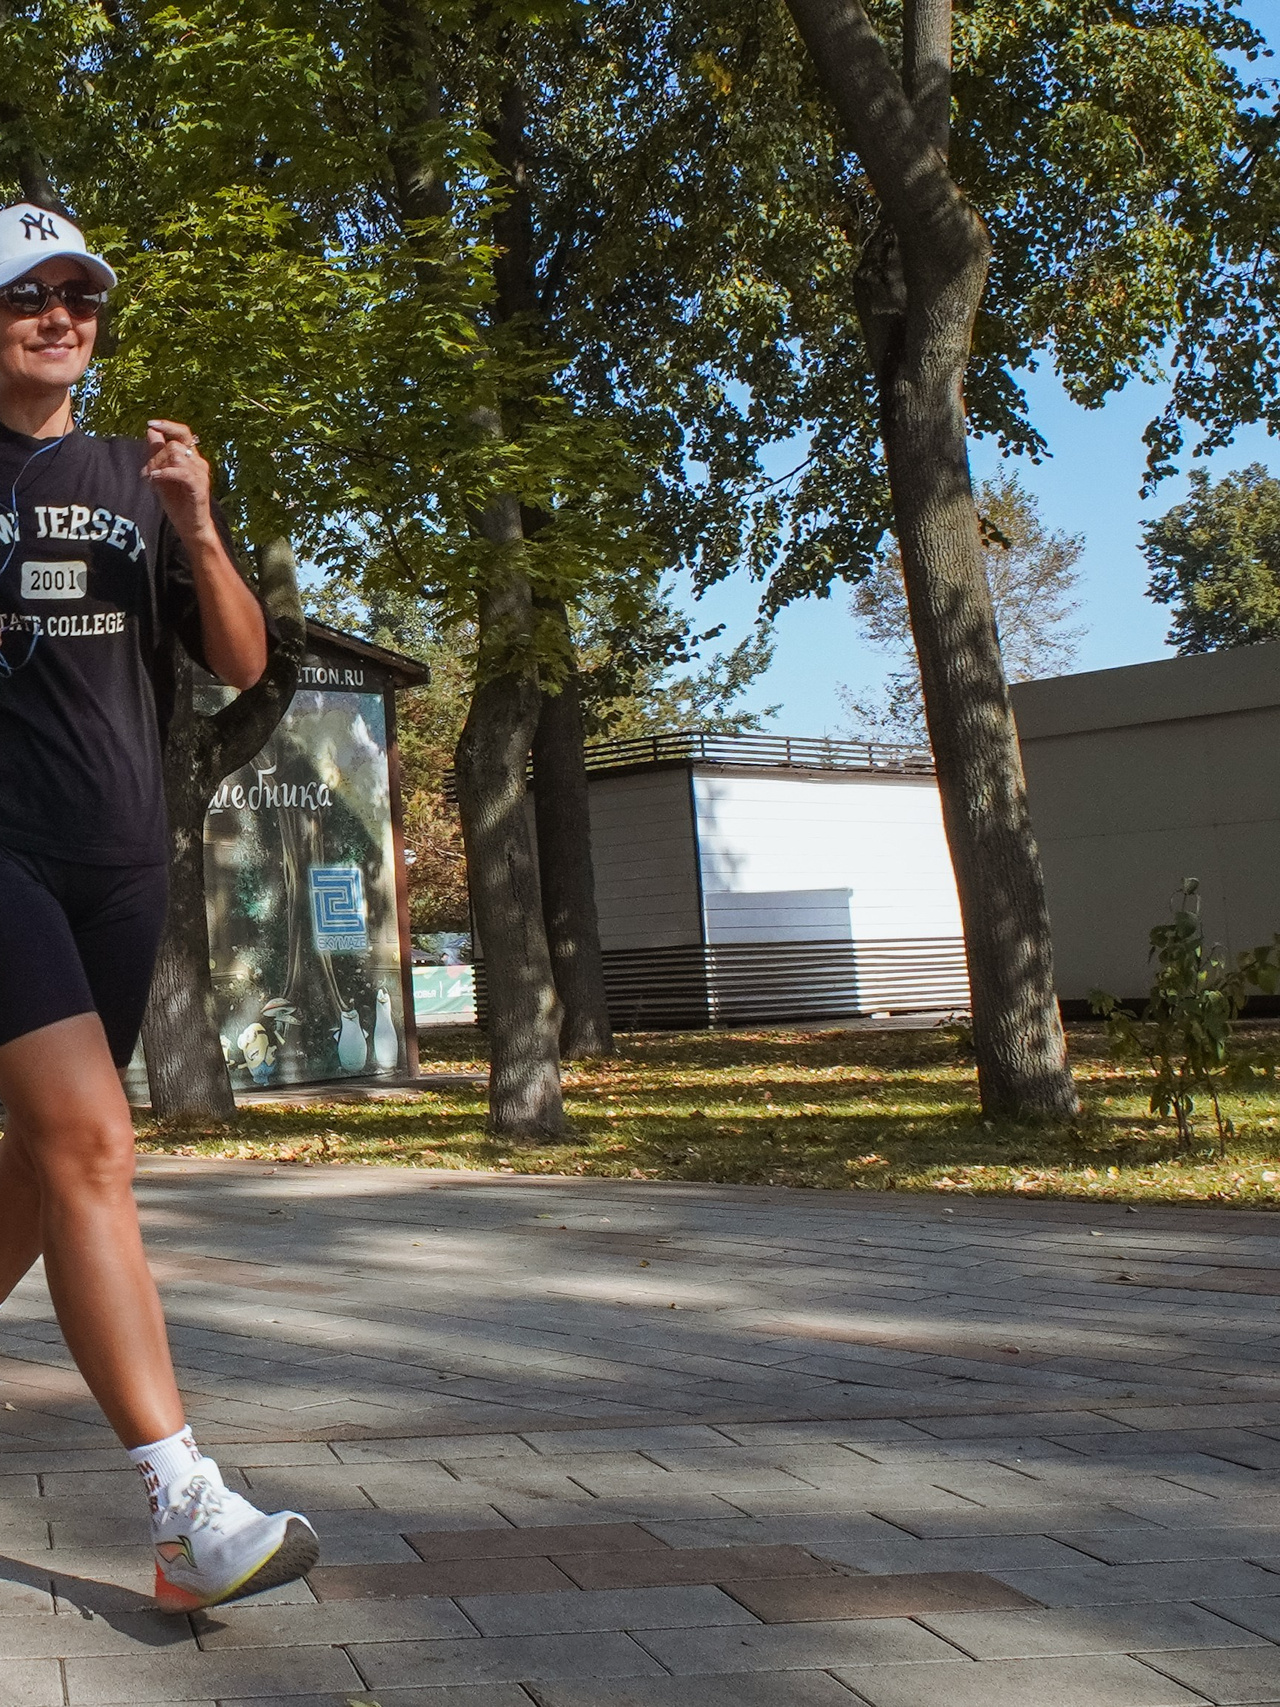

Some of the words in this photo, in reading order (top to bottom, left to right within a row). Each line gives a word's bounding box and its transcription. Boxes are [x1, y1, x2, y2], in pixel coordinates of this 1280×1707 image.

[19, 211, 60, 241] NY
[34, 504, 146, 563] JERSEY
[30, 569, 77, 591] 2001
[47, 611, 127, 637] COLLEGE
[317, 935, 367, 951] SKYMAZE
